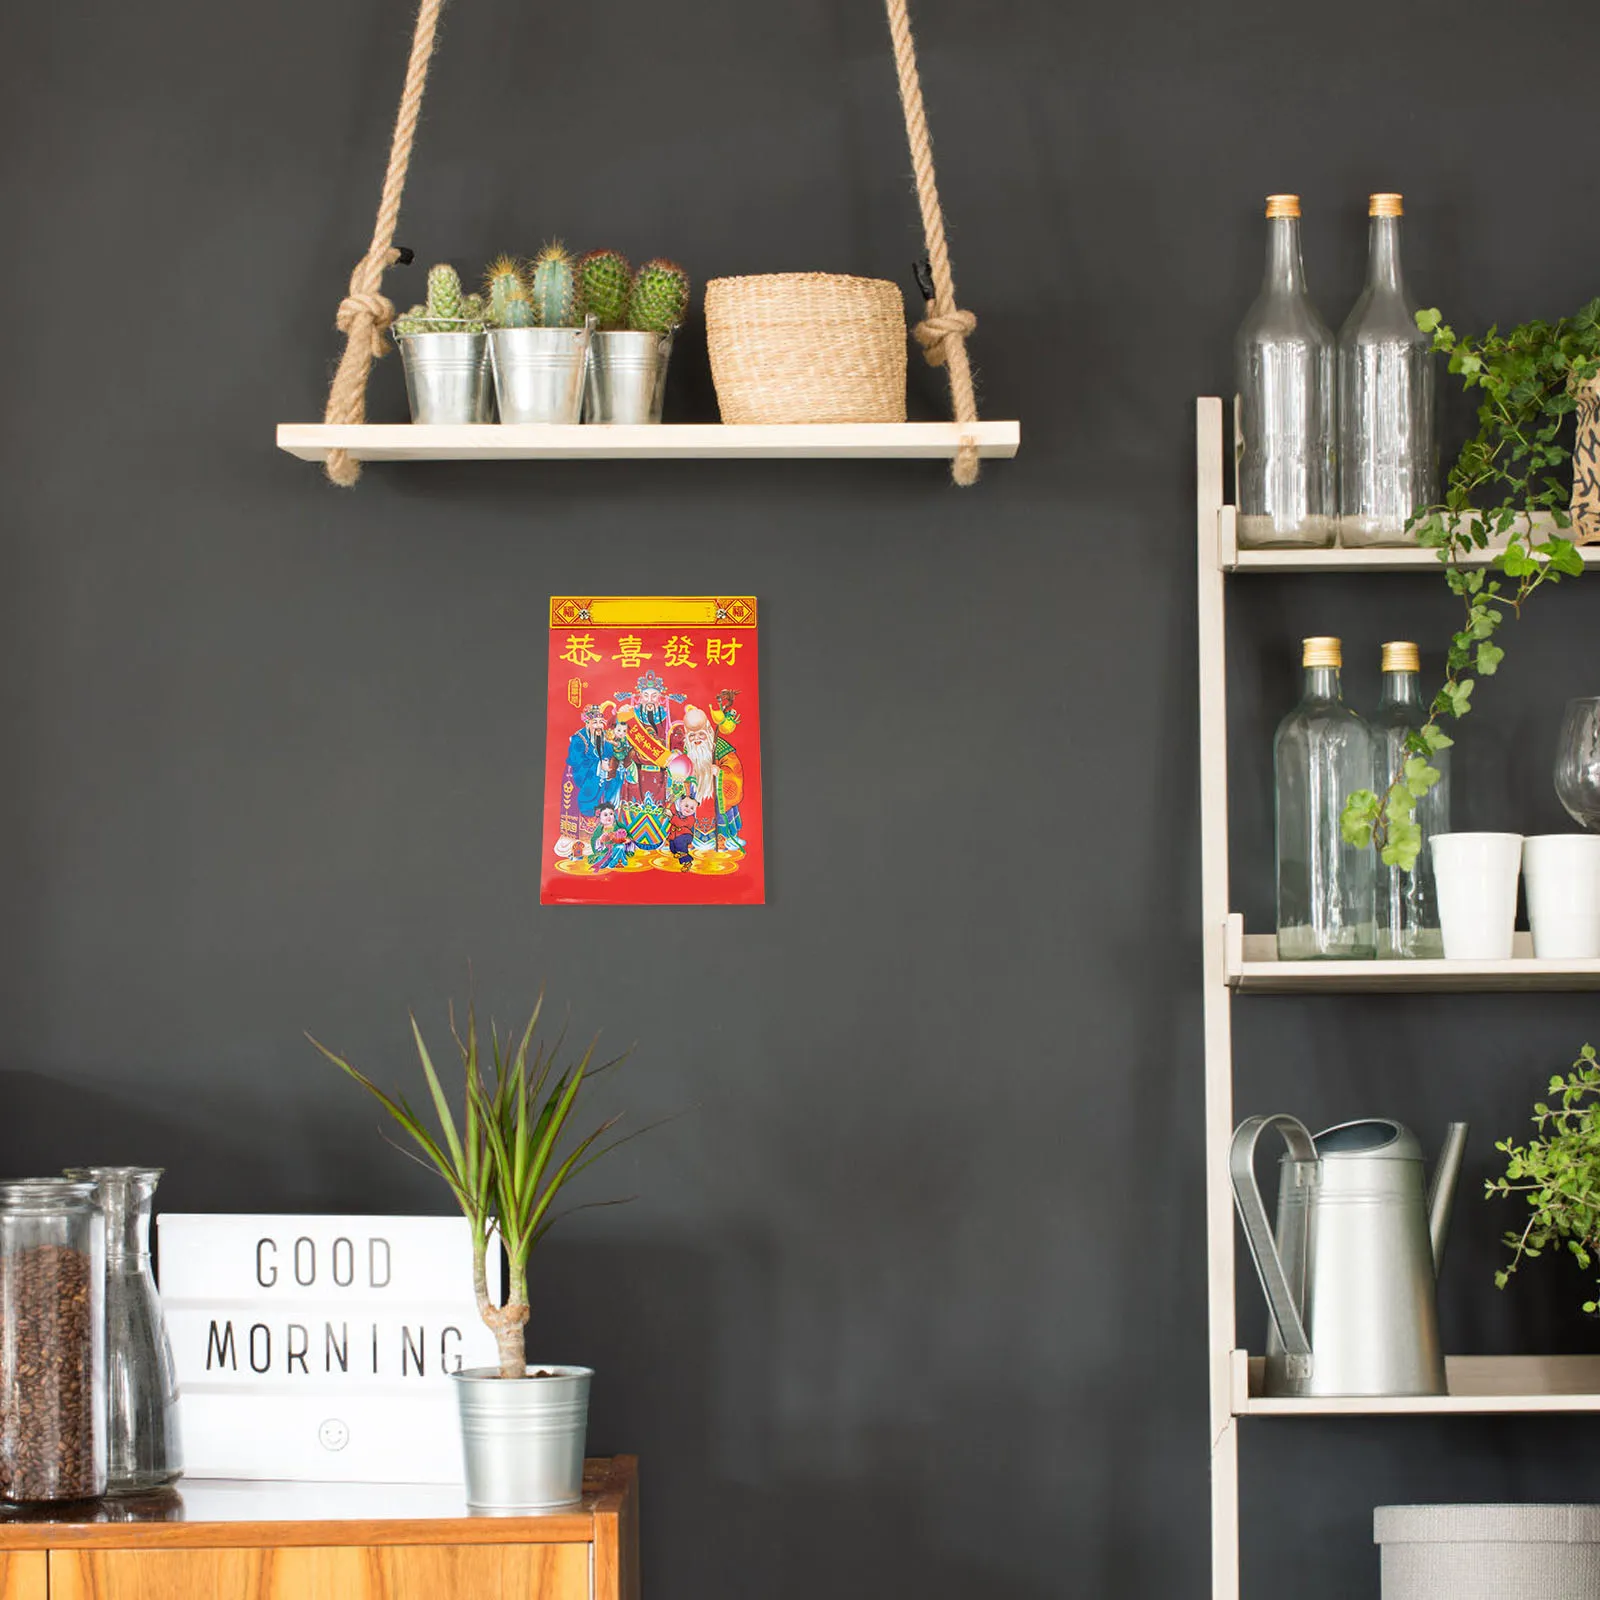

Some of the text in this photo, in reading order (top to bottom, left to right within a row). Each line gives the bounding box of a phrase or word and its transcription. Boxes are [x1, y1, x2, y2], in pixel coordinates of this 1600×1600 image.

[559, 633, 743, 669] 恭喜發財
[256, 1236, 391, 1288] GOOD
[206, 1320, 462, 1377] MORNING
